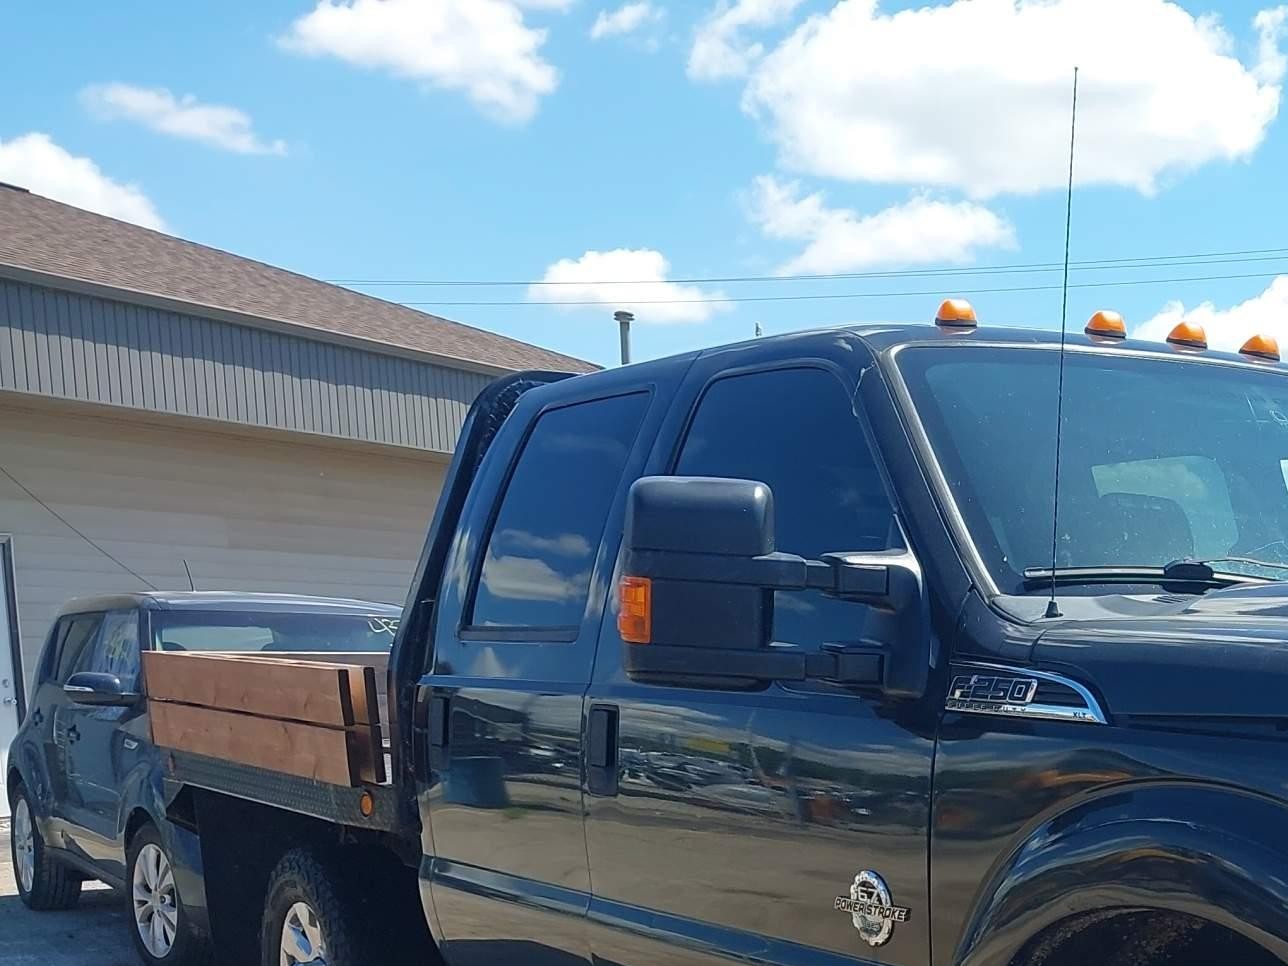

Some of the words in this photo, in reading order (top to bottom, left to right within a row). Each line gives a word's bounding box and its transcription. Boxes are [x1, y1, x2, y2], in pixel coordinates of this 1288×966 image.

[947, 675, 1038, 703] F-250
[836, 898, 865, 912] POWER
[866, 905, 905, 920] STROKE
